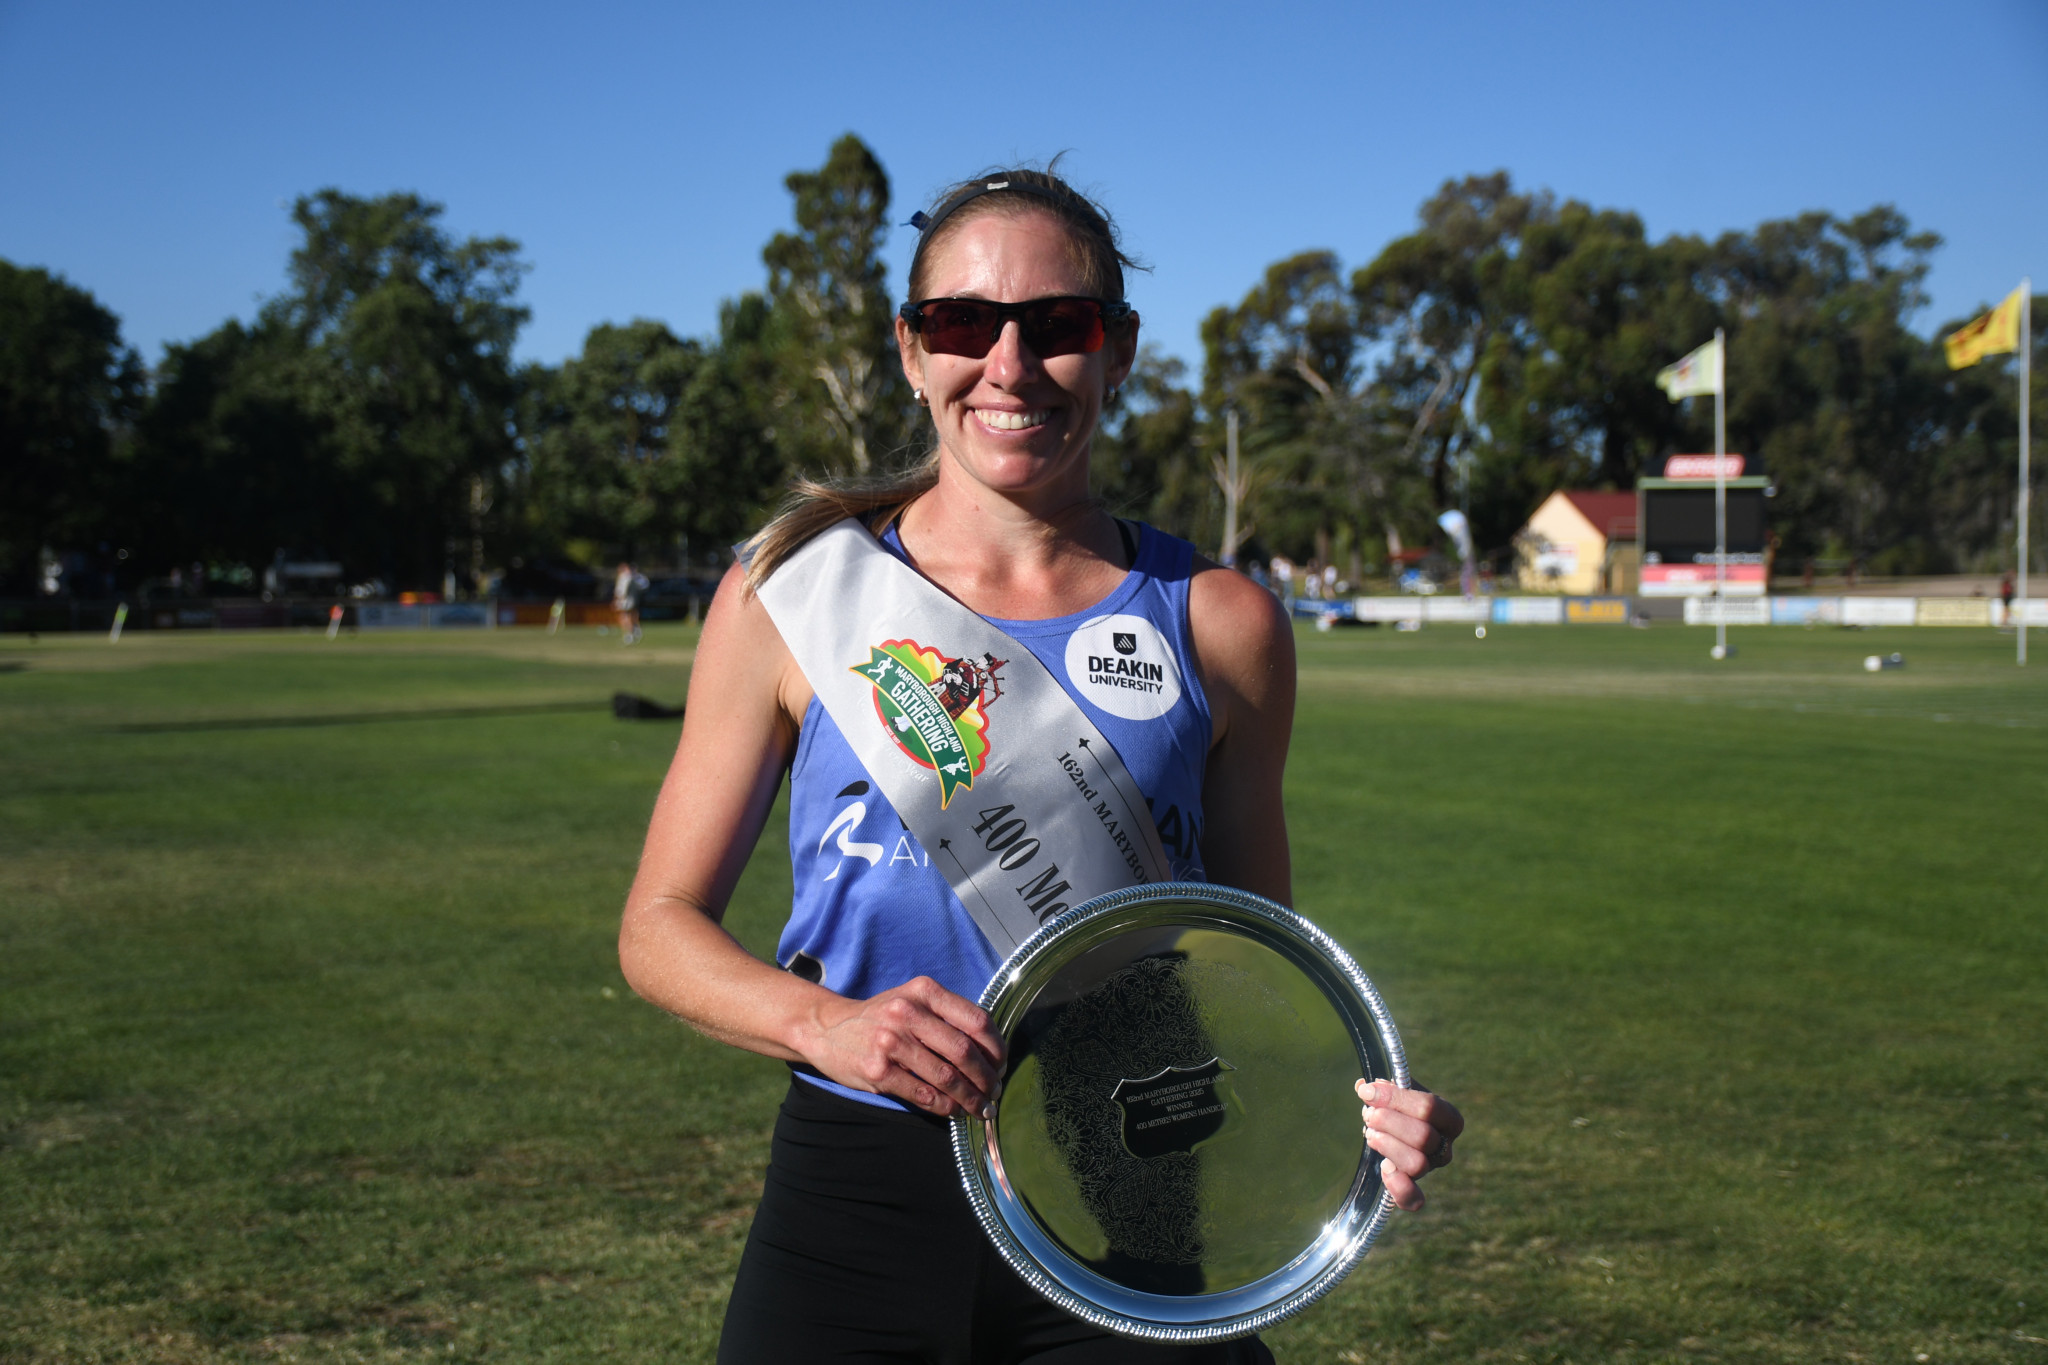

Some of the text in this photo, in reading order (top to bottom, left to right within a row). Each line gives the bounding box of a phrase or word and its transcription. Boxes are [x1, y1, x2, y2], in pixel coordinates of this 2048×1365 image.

[1088, 655, 1163, 682] DEAKIN
[1089, 674, 1163, 695] UNIVERSITY
[891, 681, 949, 752] GATHERING
[895, 665, 941, 714] MARYBOROUGH
[936, 713, 963, 753] HIGHLAND
[1057, 751, 1098, 802] 162nd
[971, 804, 1041, 871] 400
[1144, 1081, 1192, 1099] MARYBOROUGH
[1192, 1074, 1225, 1089] HIGHLAND
[1150, 1091, 1188, 1106] GATHERING
[1147, 1116, 1172, 1127] METRES
[1172, 1110, 1198, 1121] WOMENS
[1197, 1102, 1229, 1116] HANDICAP
[1166, 1100, 1194, 1112] WINNER
